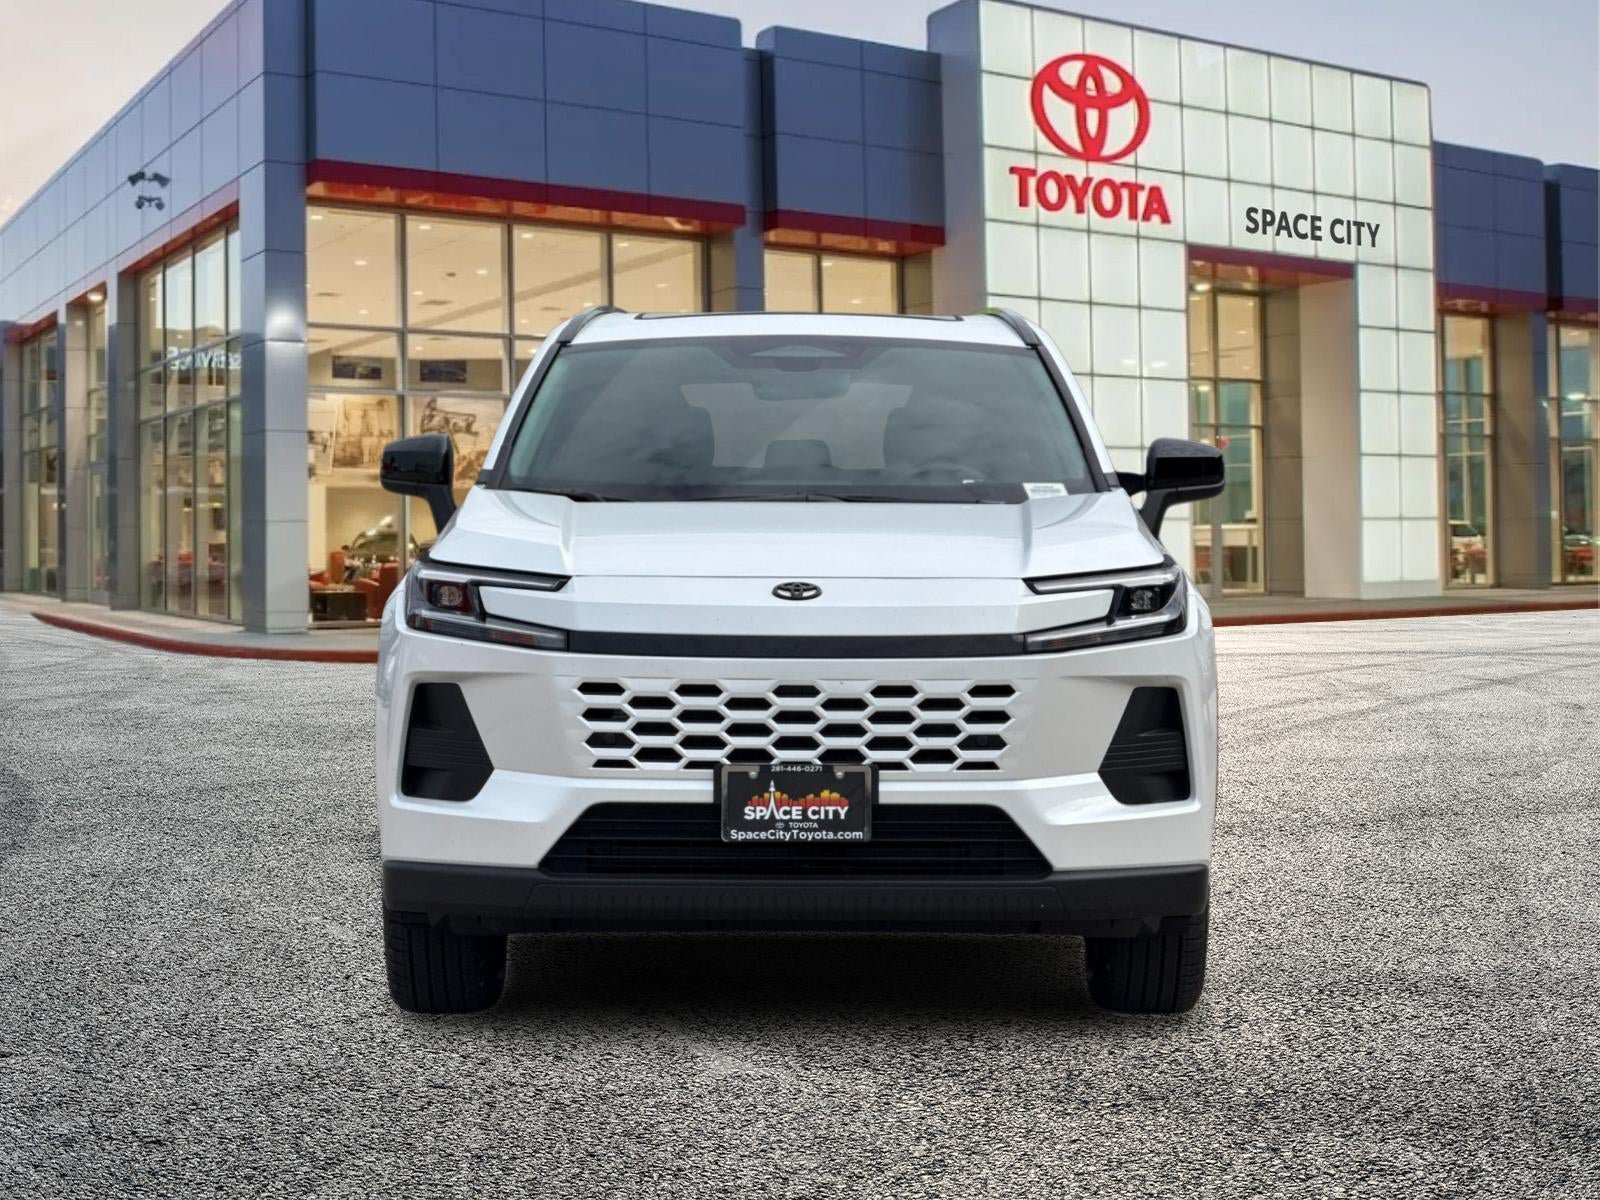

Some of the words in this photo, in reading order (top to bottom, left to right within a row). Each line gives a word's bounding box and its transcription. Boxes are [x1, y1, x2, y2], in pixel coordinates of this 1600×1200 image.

[1009, 166, 1172, 224] TOYOTA
[1245, 206, 1323, 242] SPACE
[1329, 217, 1381, 248] CITY
[771, 765, 823, 773] 281-446-0271
[744, 795, 803, 821] SPACE
[807, 806, 849, 820] CITY
[730, 829, 863, 841] SpaceCityToyota.com
